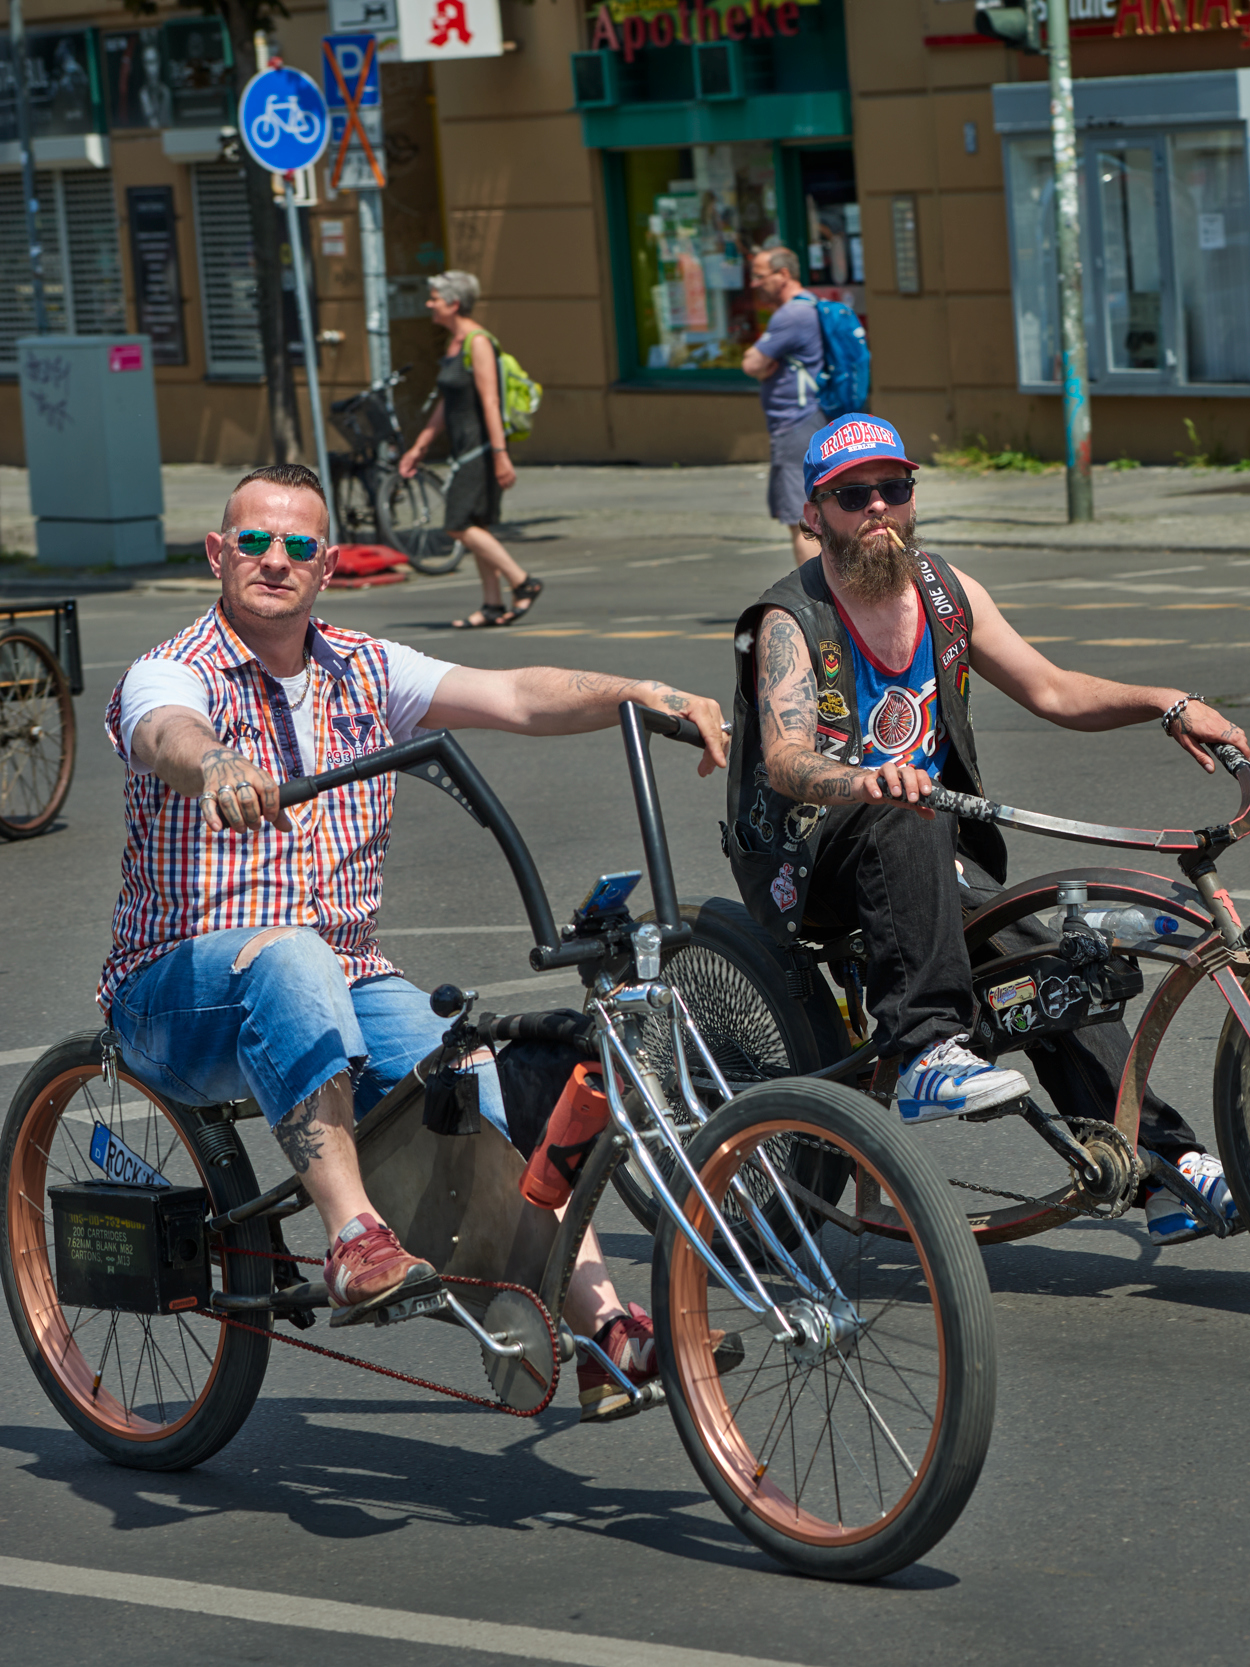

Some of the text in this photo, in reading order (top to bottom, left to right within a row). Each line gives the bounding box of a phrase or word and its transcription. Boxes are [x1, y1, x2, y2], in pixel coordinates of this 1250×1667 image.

[592, 0, 800, 63] Apotheke
[820, 421, 896, 460] IRIEDAILY
[919, 560, 953, 614] ONE BIG
[941, 644, 959, 666] EAZY
[326, 751, 352, 764] 893
[72, 1226, 128, 1243] 200 CARTRIDGES
[346, 1228, 359, 1240] 574
[96, 1240, 118, 1253] BLANK
[120, 1243, 134, 1256] M82
